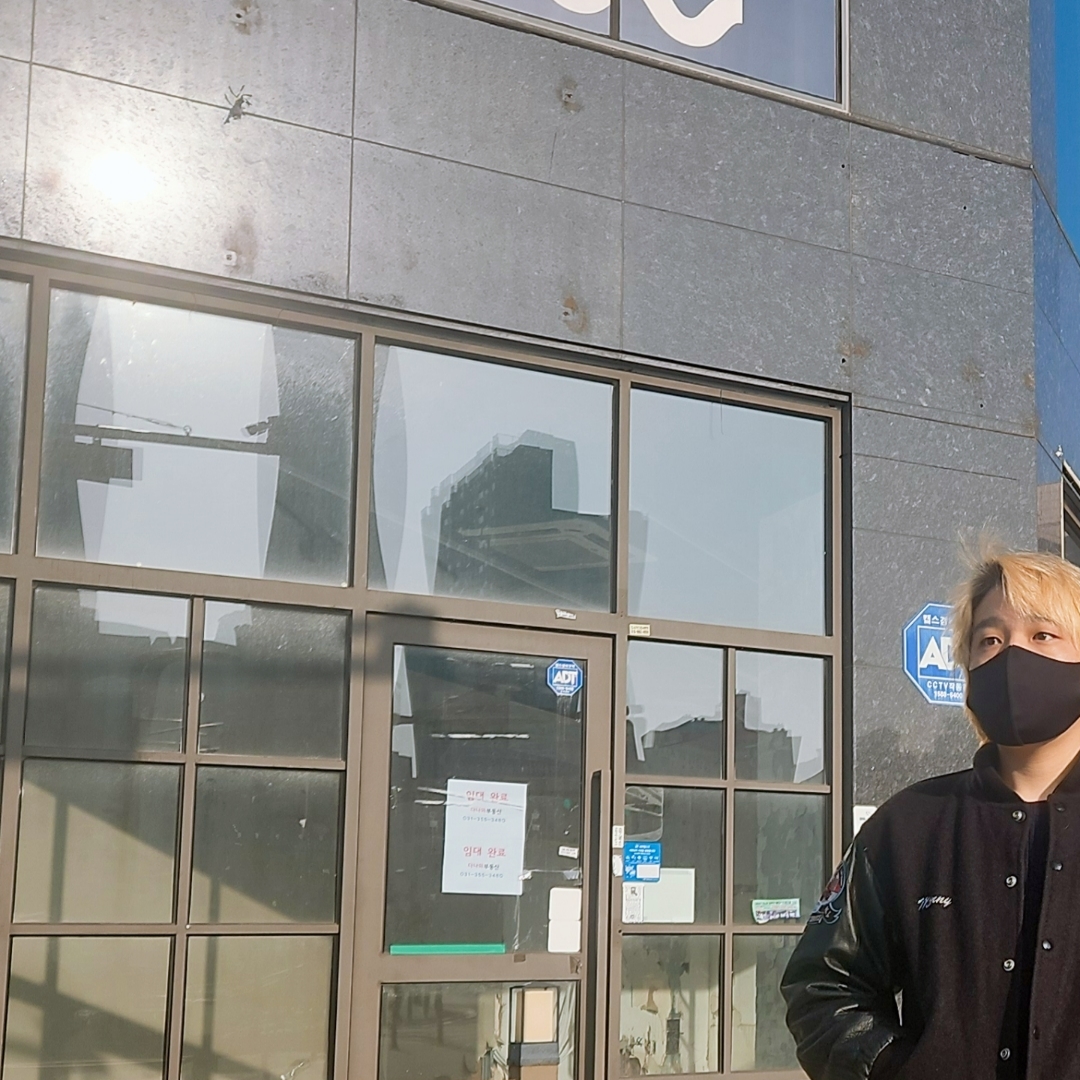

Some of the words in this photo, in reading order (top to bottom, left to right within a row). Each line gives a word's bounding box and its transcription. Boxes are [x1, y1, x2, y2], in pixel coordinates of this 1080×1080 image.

[552, 670, 578, 686] ADT
[466, 790, 485, 801] 임대
[463, 846, 482, 857] 임대
[487, 847, 506, 858] 완료
